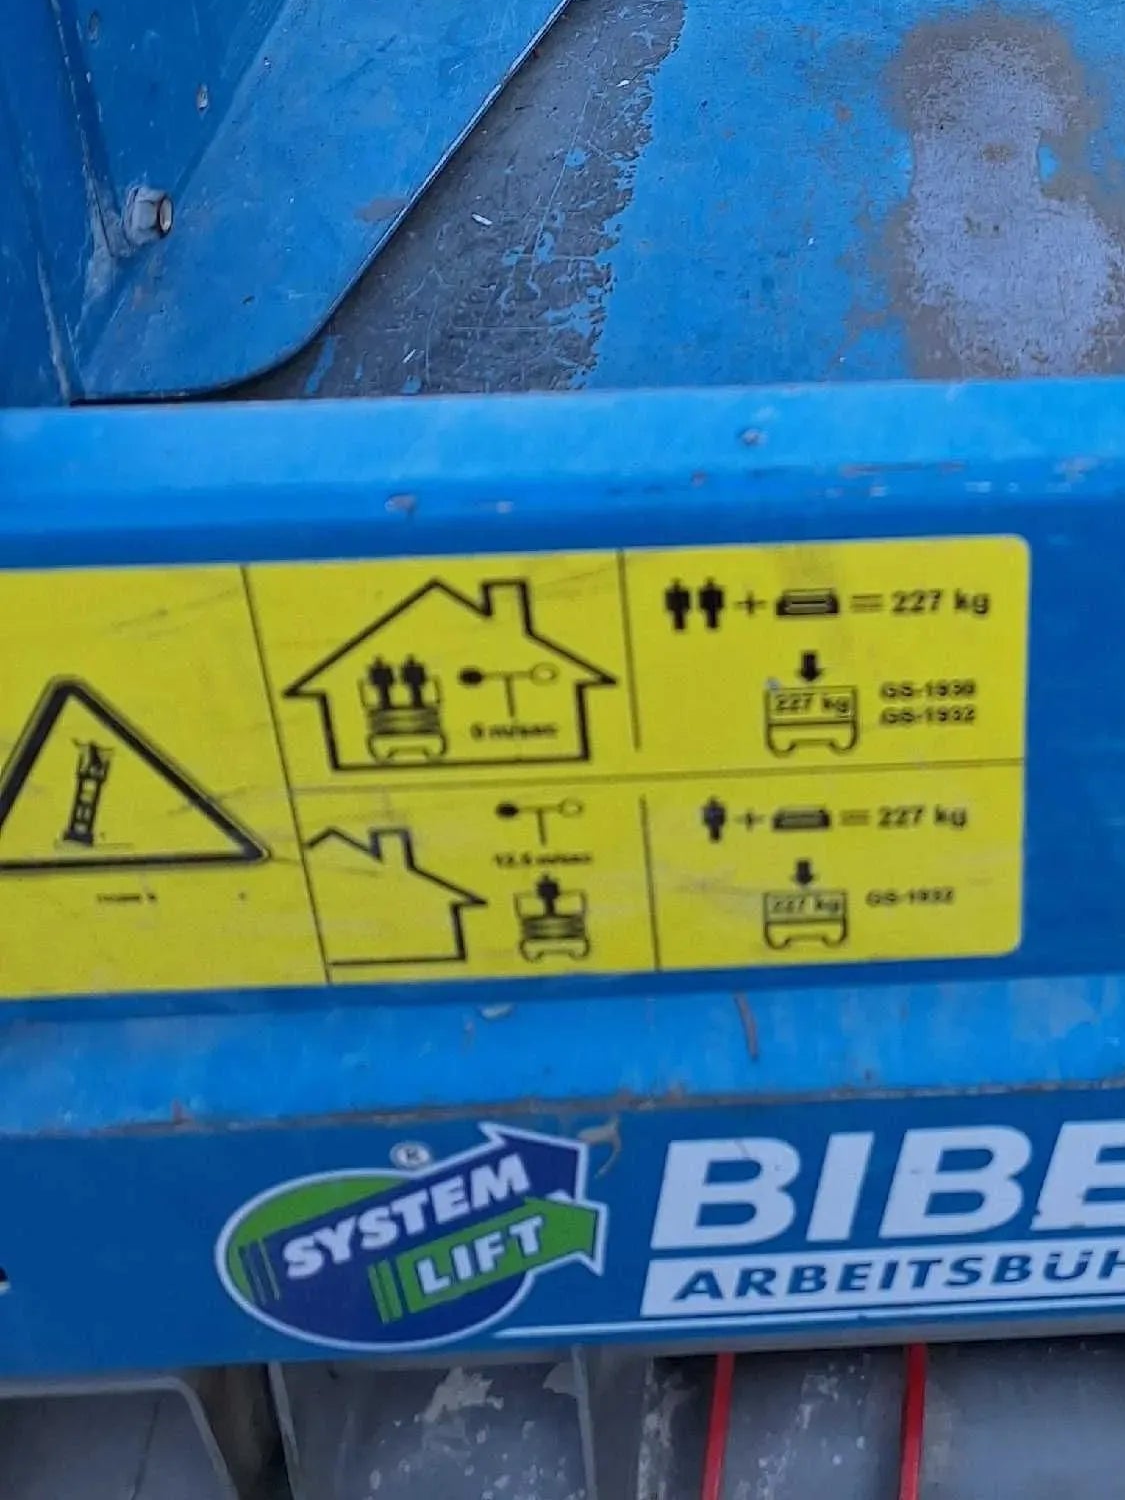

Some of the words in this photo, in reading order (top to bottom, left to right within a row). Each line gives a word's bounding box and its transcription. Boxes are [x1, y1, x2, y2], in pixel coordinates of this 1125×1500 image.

[953, 587, 990, 618] kg
[775, 693, 815, 713] 227
[823, 691, 850, 717] kg
[935, 804, 968, 828] kg
[282, 1154, 531, 1280] SYSTEM
[416, 1215, 545, 1296] LIFT
